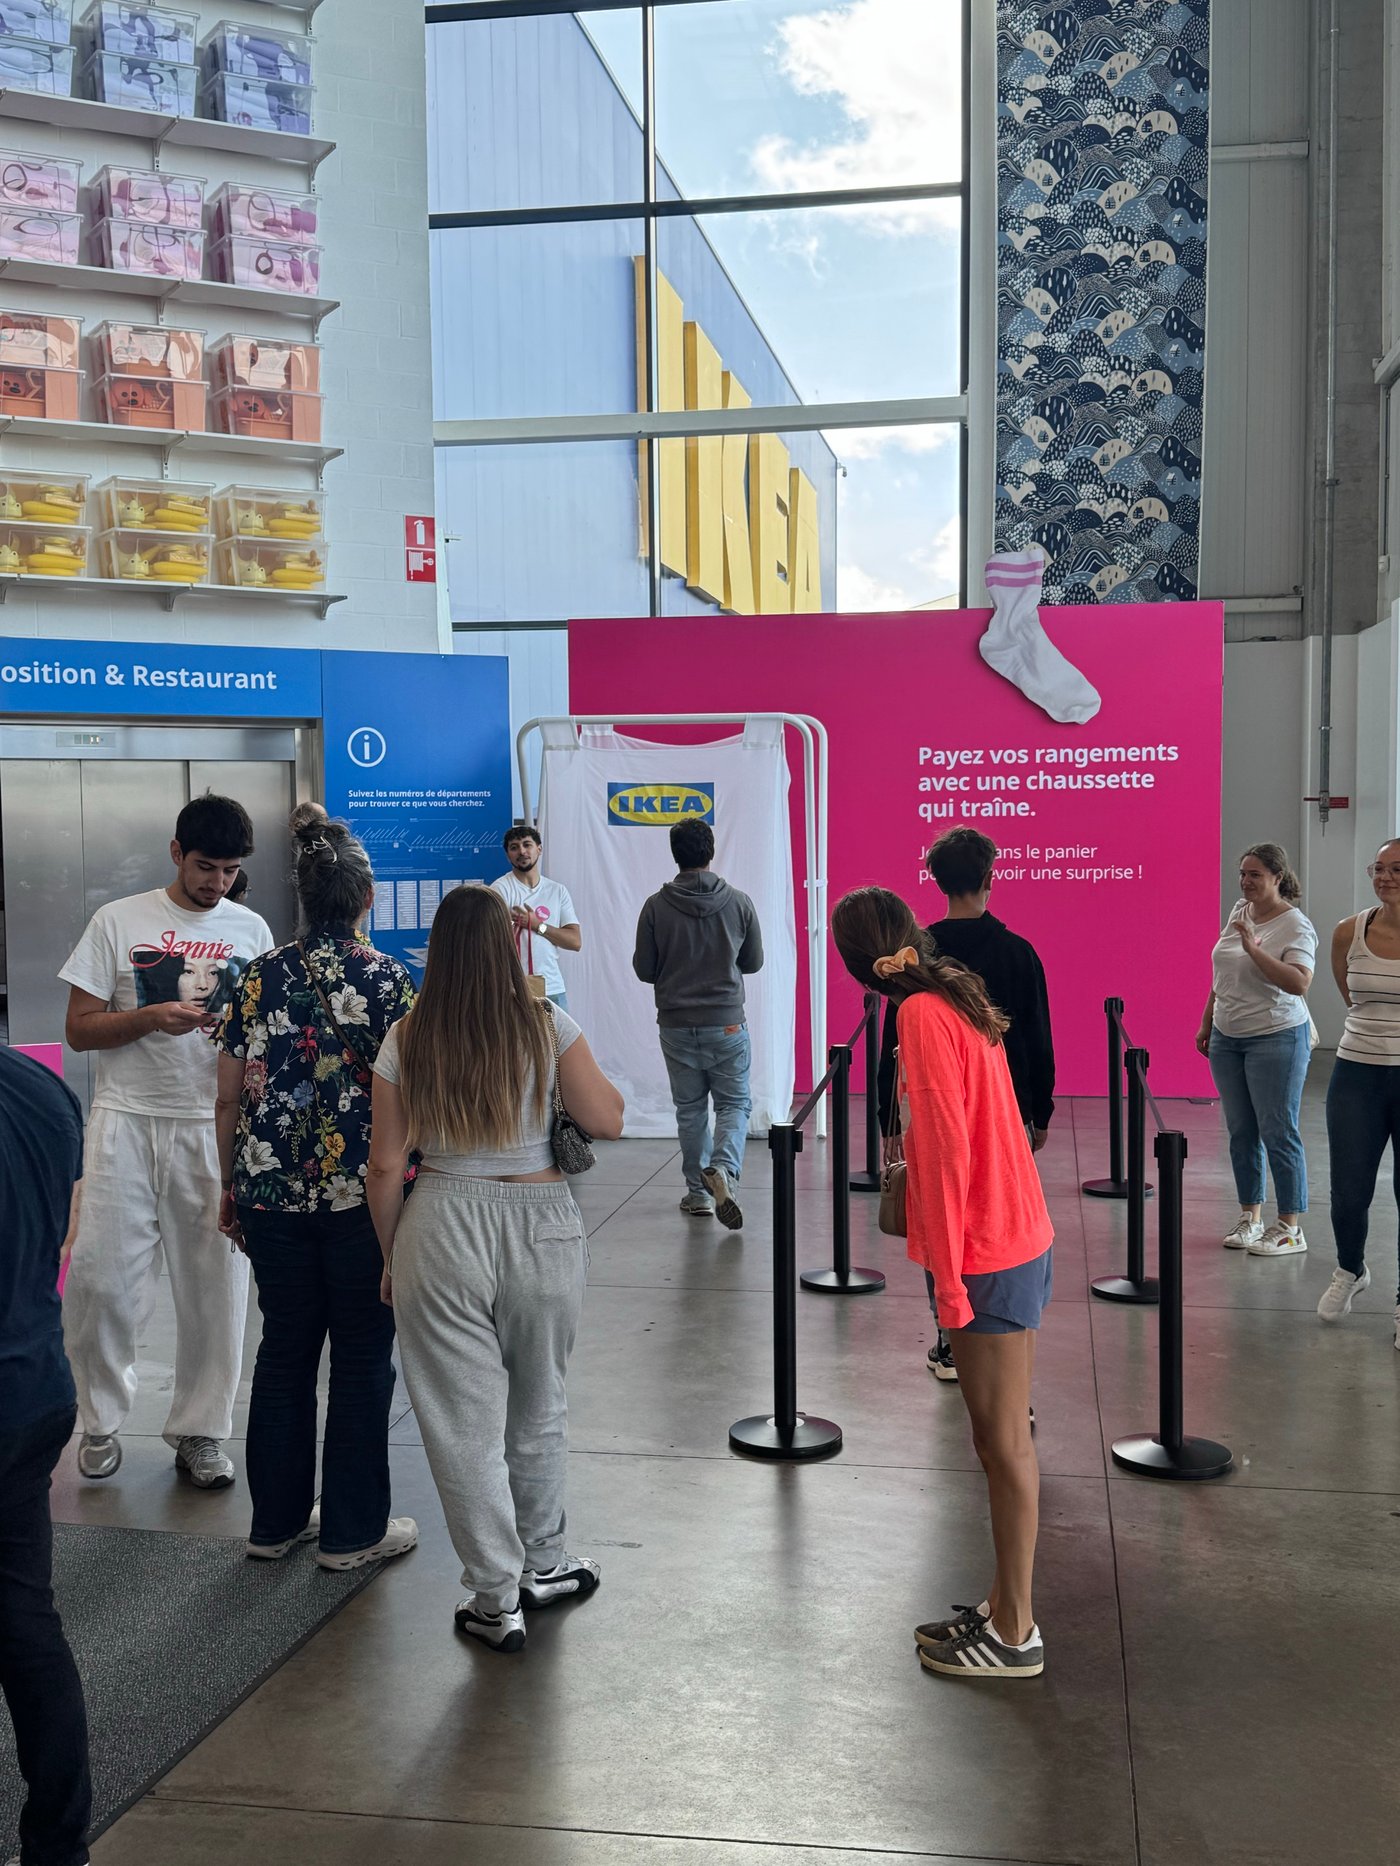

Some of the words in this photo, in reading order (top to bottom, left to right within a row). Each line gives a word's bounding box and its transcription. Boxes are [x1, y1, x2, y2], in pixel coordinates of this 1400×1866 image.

[633, 255, 822, 615] IKEA
[105, 664, 125, 685] &
[133, 665, 278, 690] Restaurant
[918, 747, 985, 771] Payez
[989, 749, 1029, 764] vos
[1035, 743, 1179, 769] rangements
[918, 776, 970, 792] avec
[976, 775, 1021, 791] une
[1026, 770, 1155, 790] chaussette
[348, 789, 374, 798] Suivez
[376, 789, 387, 798] les
[389, 789, 424, 798] numéros
[425, 789, 436, 798] de
[437, 789, 491, 799] départements
[348, 800, 367, 809] pour
[370, 800, 399, 808] trouver
[412, 800, 427, 809] que
[448, 799, 485, 807] cherchez.
[618, 795, 706, 813] IKEA
[918, 798, 954, 823] qui
[960, 797, 1036, 818] traîne.
[994, 848, 1022, 860] ans
[1026, 844, 1041, 859] le
[1045, 844, 1098, 863] panier
[1031, 868, 1062, 880] une
[1066, 866, 1134, 884] surprise
[1138, 865, 1143, 879] !
[129, 930, 234, 968] Jennie
